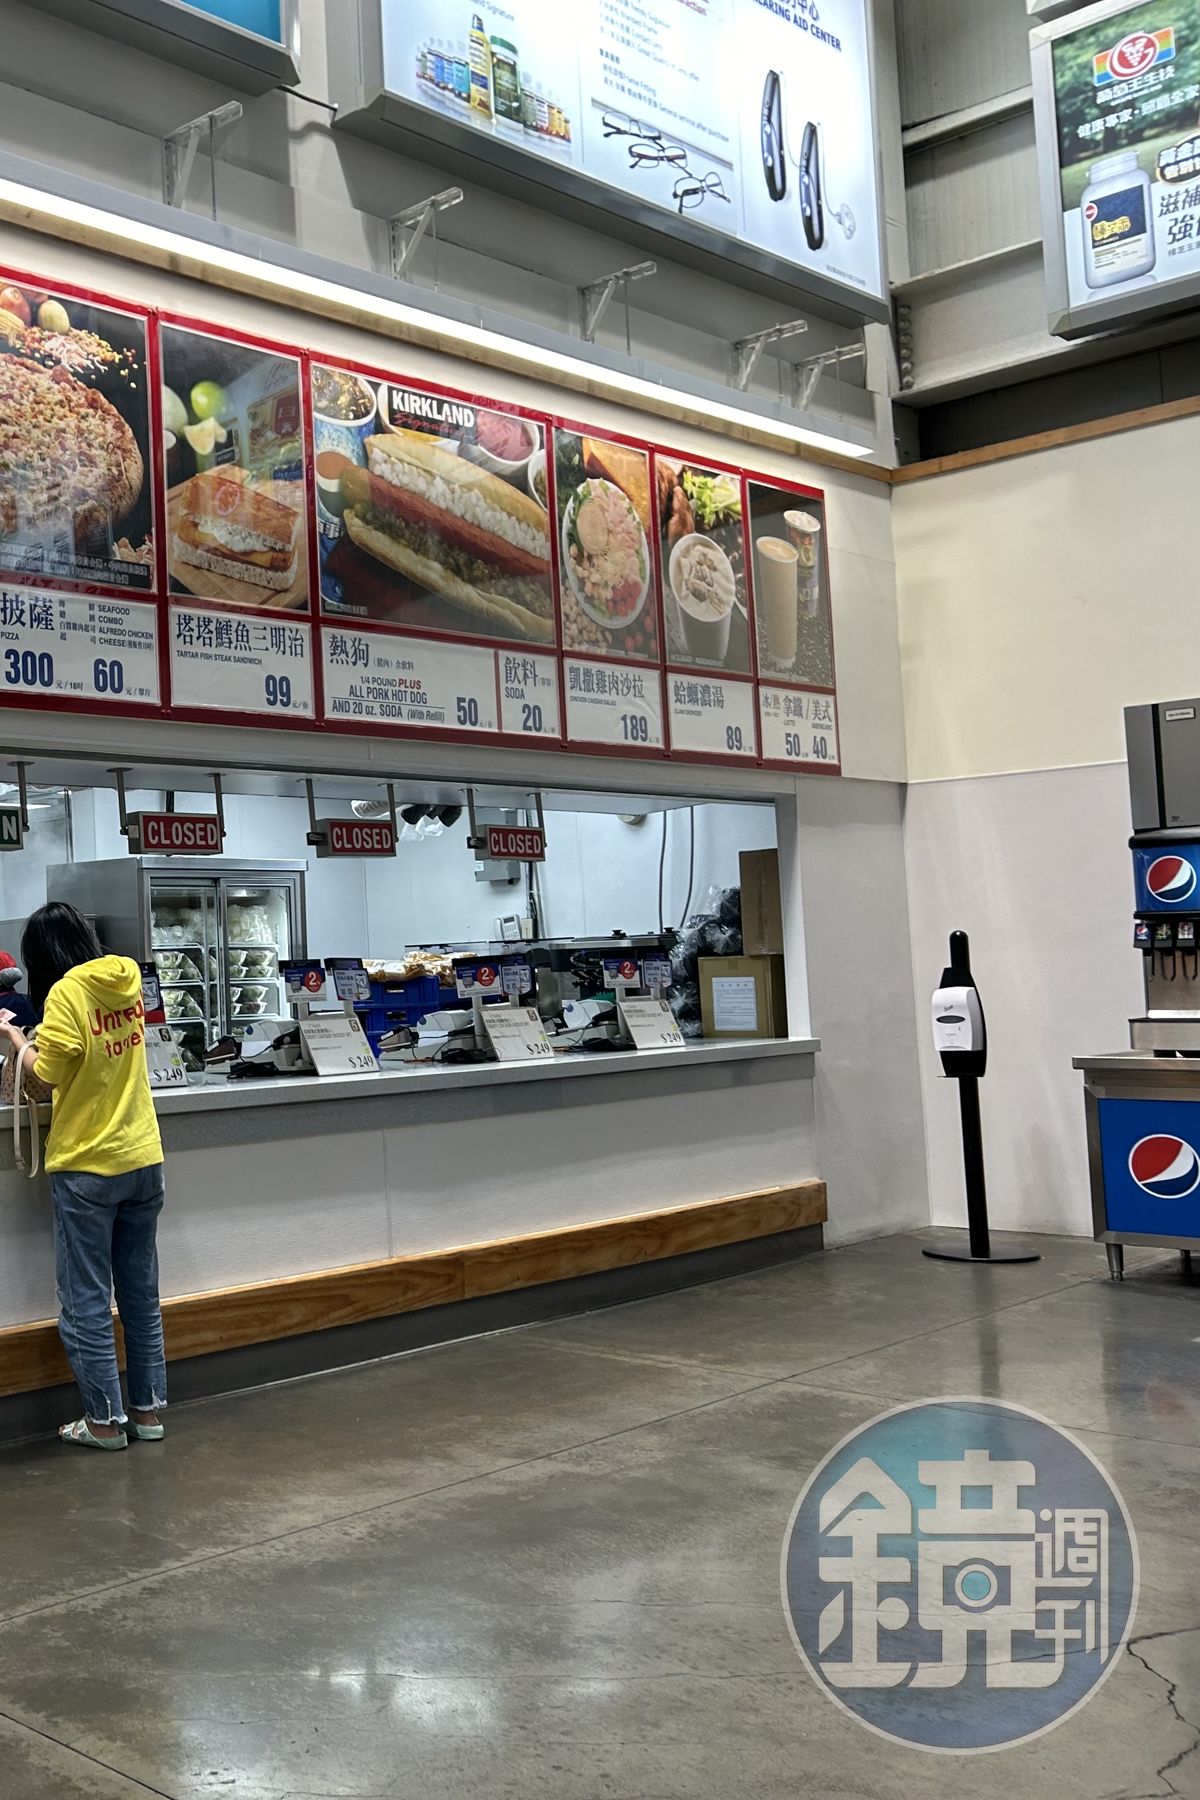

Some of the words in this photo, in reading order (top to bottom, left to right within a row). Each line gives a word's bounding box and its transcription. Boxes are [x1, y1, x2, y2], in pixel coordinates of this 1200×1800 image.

[793, 13, 808, 31] AID
[810, 23, 841, 51] CENTER
[1166, 214, 1200, 245] 強
[392, 390, 474, 428] KIRKLAND
[0, 591, 55, 631] 披薩
[98, 604, 130, 615] SEAFOOD
[98, 615, 123, 625] COMBO
[0, 631, 19, 640] PIZZA
[98, 626, 126, 636] ALFREDO
[127, 630, 153, 639] CHICKEN
[98, 637, 126, 647] CHEESE
[176, 613, 304, 658] 塔塔鱈魚三明治
[176, 650, 199, 659] TARTAR
[200, 652, 212, 660] FISH
[213, 654, 232, 663] STEAK
[233, 655, 262, 665] SANDWICH
[329, 634, 369, 668] 熱狗
[4, 648, 54, 687] 300
[93, 658, 123, 694] 60
[504, 656, 538, 687] 飲料
[265, 674, 291, 707] 99
[349, 685, 366, 698] ALL
[366, 687, 390, 701] PORK
[391, 690, 407, 702] HOT
[410, 691, 428, 704] DOG
[360, 675, 370, 685] 1/4
[371, 677, 397, 688] POUND
[398, 678, 422, 690] PLUS
[505, 686, 525, 700] SODA
[569, 666, 644, 698] 凱撒雞肉沙拉
[674, 680, 724, 709] 蛤蠣濃湯
[332, 699, 350, 713] AND
[352, 702, 363, 715] 20
[365, 705, 377, 716] oz.
[379, 704, 403, 718] SODA
[407, 708, 424, 721] (With
[425, 710, 445, 724] Refill)
[456, 696, 479, 727] 50
[522, 703, 542, 732] 20
[621, 714, 648, 742] 189
[726, 725, 742, 751] 89
[785, 732, 800, 757] 50
[813, 736, 827, 759] 40
[147, 820, 218, 846] CLOSED
[332, 827, 391, 850] CLOSED
[490, 837, 541, 854] CLOSED
